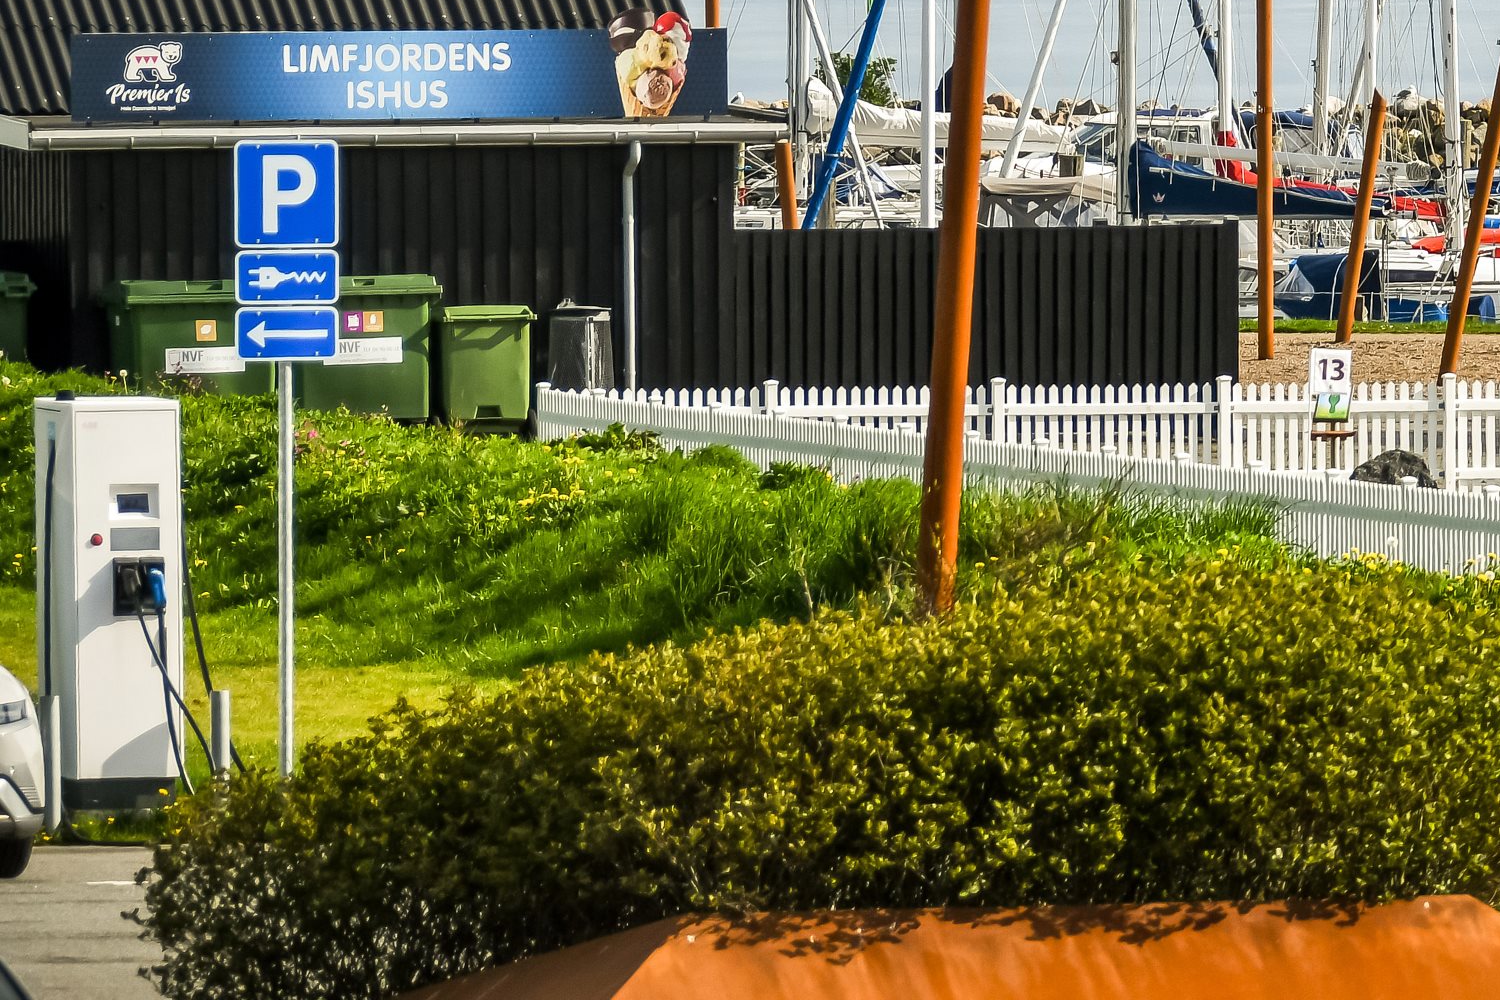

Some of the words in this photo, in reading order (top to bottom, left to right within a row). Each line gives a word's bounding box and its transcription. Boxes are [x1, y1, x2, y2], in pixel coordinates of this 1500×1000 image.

[282, 42, 513, 73] LIMFJORDENS
[105, 83, 174, 104] Premier
[174, 82, 191, 104] Is
[347, 79, 449, 109] ISHUS
[262, 154, 317, 234] P
[182, 350, 204, 362] NVF
[339, 341, 361, 354] NVF
[1318, 358, 1345, 381] 13
